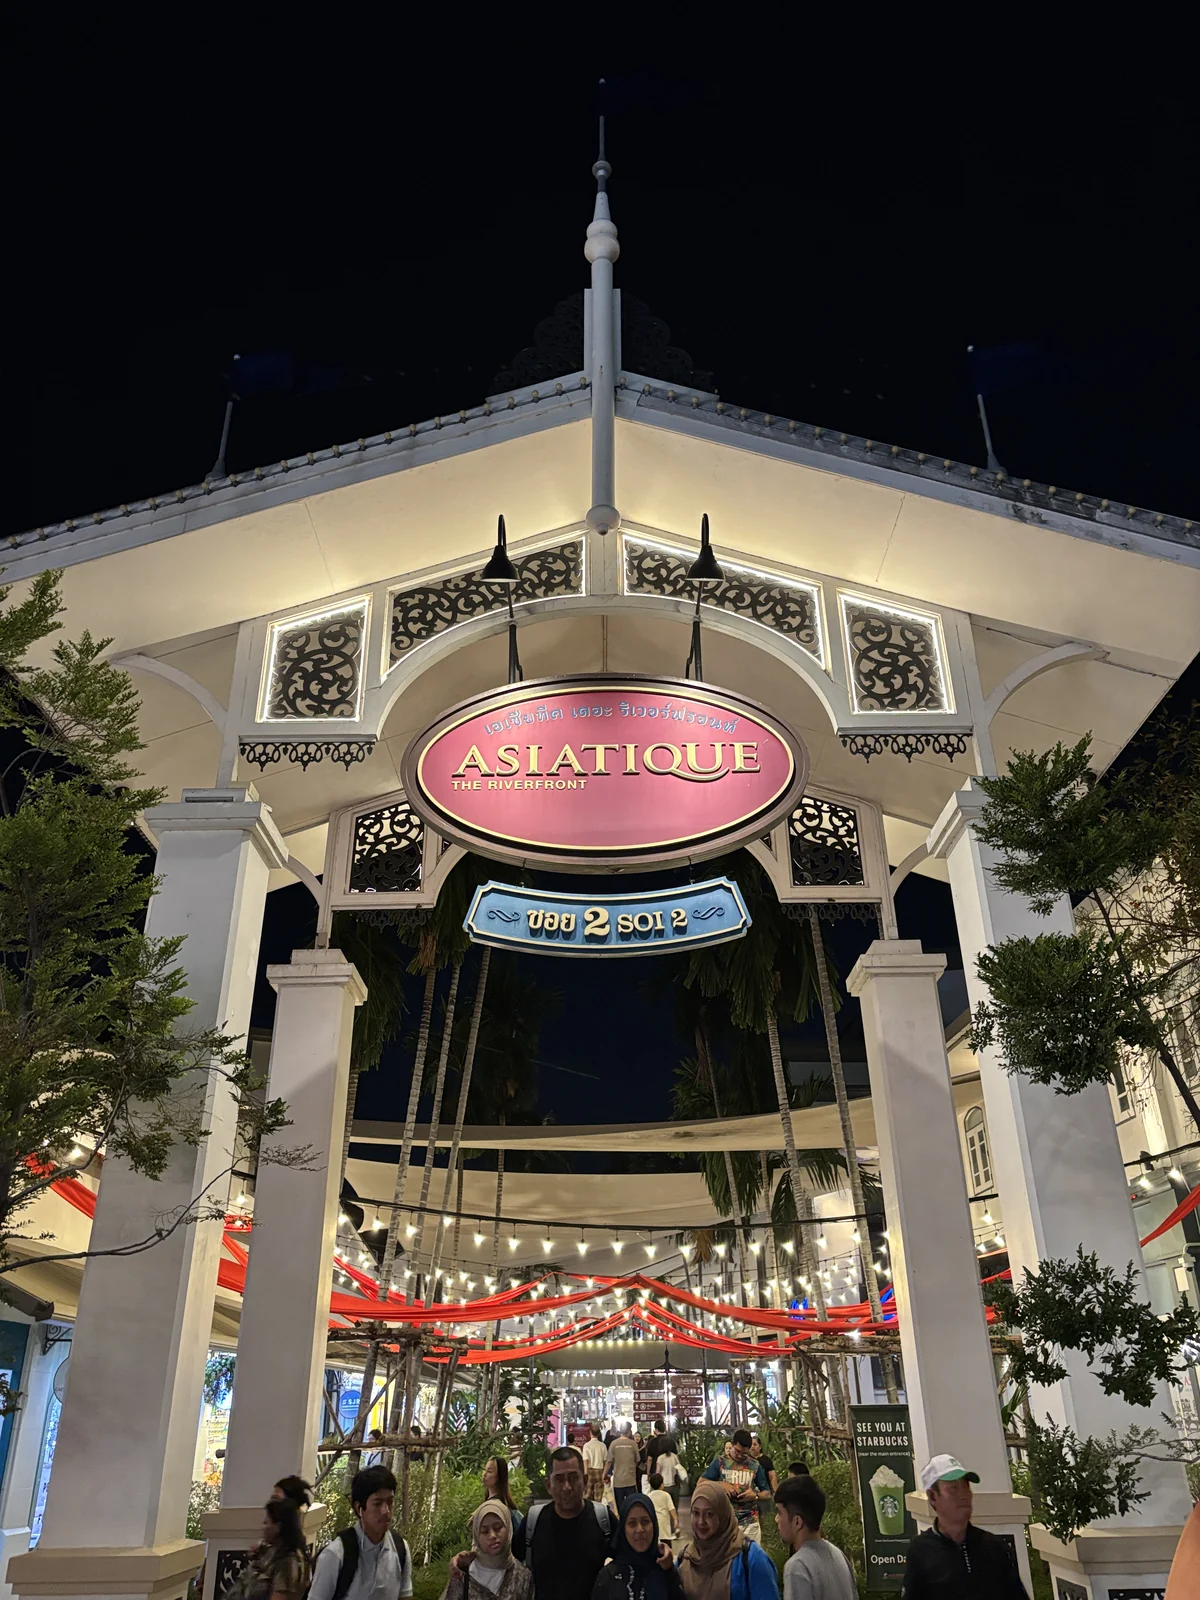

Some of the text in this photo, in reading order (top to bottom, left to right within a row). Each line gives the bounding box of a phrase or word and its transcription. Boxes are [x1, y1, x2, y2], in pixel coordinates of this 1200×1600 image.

[571, 705, 613, 719] เดอะ
[451, 742, 761, 783] ASIATIQUE
[451, 779, 587, 791] THE RIVERFRONT
[526, 906, 688, 937] ซอย 2 SOI 2
[856, 1422, 906, 1433] SEE YOU AT
[856, 1436, 909, 1447] STARBUCKS
[731, 1470, 754, 1487] RUN
[870, 1554, 896, 1566] Open
